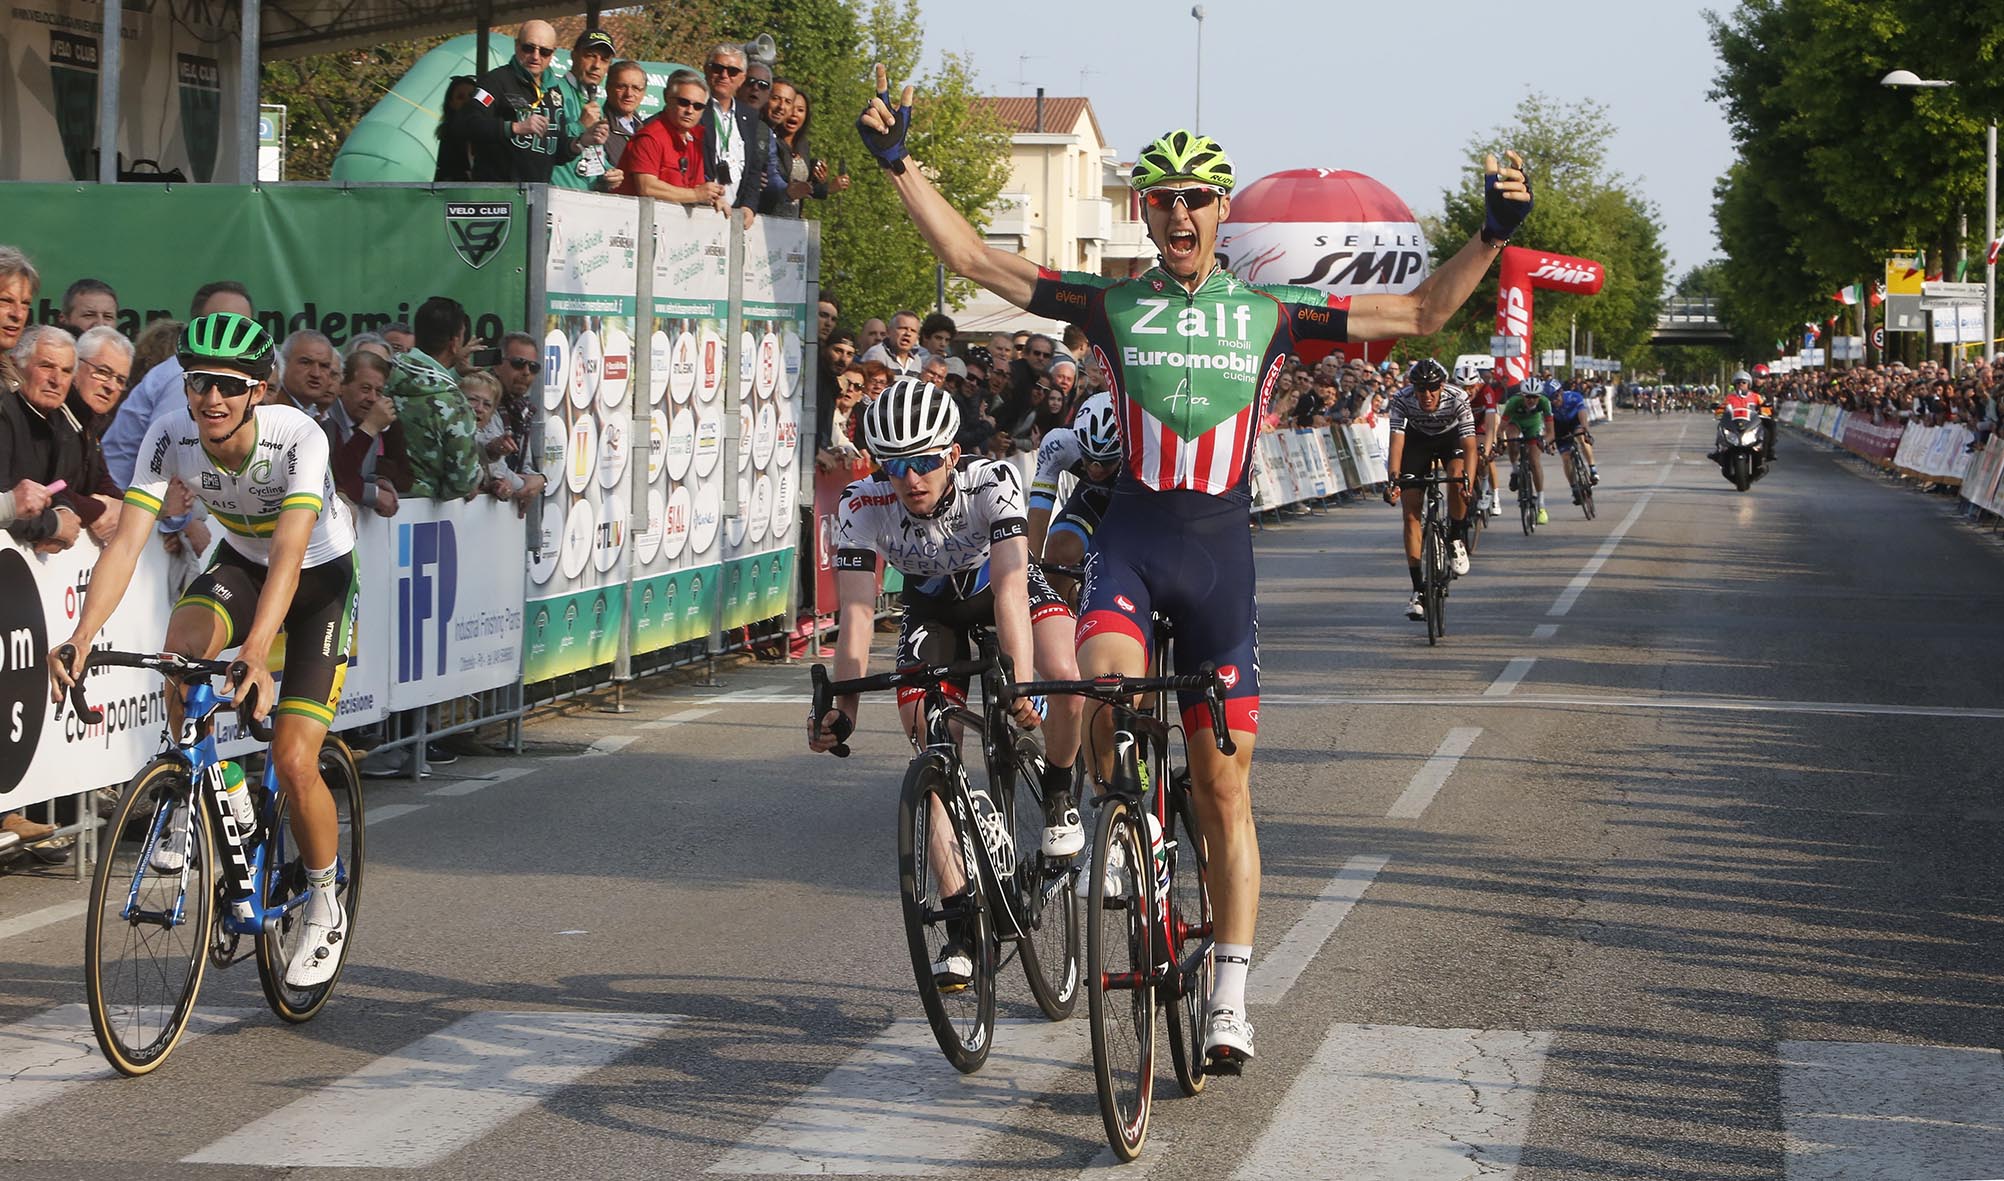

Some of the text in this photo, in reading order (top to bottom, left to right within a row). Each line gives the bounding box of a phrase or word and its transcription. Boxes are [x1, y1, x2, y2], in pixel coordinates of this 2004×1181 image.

[1209, 174, 1233, 185] RUDY
[449, 206, 508, 215] VELO CLUB
[1314, 235, 1419, 247] SELLE
[1288, 251, 1423, 285] SMP
[1540, 258, 1597, 272] SELLE
[1528, 265, 1596, 285] SMP
[1130, 298, 1252, 341] Zalf
[1297, 307, 1331, 324] eVent
[1217, 338, 1252, 351] mobili
[1123, 346, 1259, 375] Euromobil
[1222, 370, 1256, 384] cucine
[258, 438, 284, 451] Jayco
[249, 486, 286, 497] Cycling
[211, 500, 237, 510] AIS
[888, 531, 987, 560] HAGENS
[322, 621, 336, 657] AUSTRALIA
[336, 692, 374, 716] recisione
[64, 682, 166, 750] component
[207, 762, 256, 893] SCOTT
